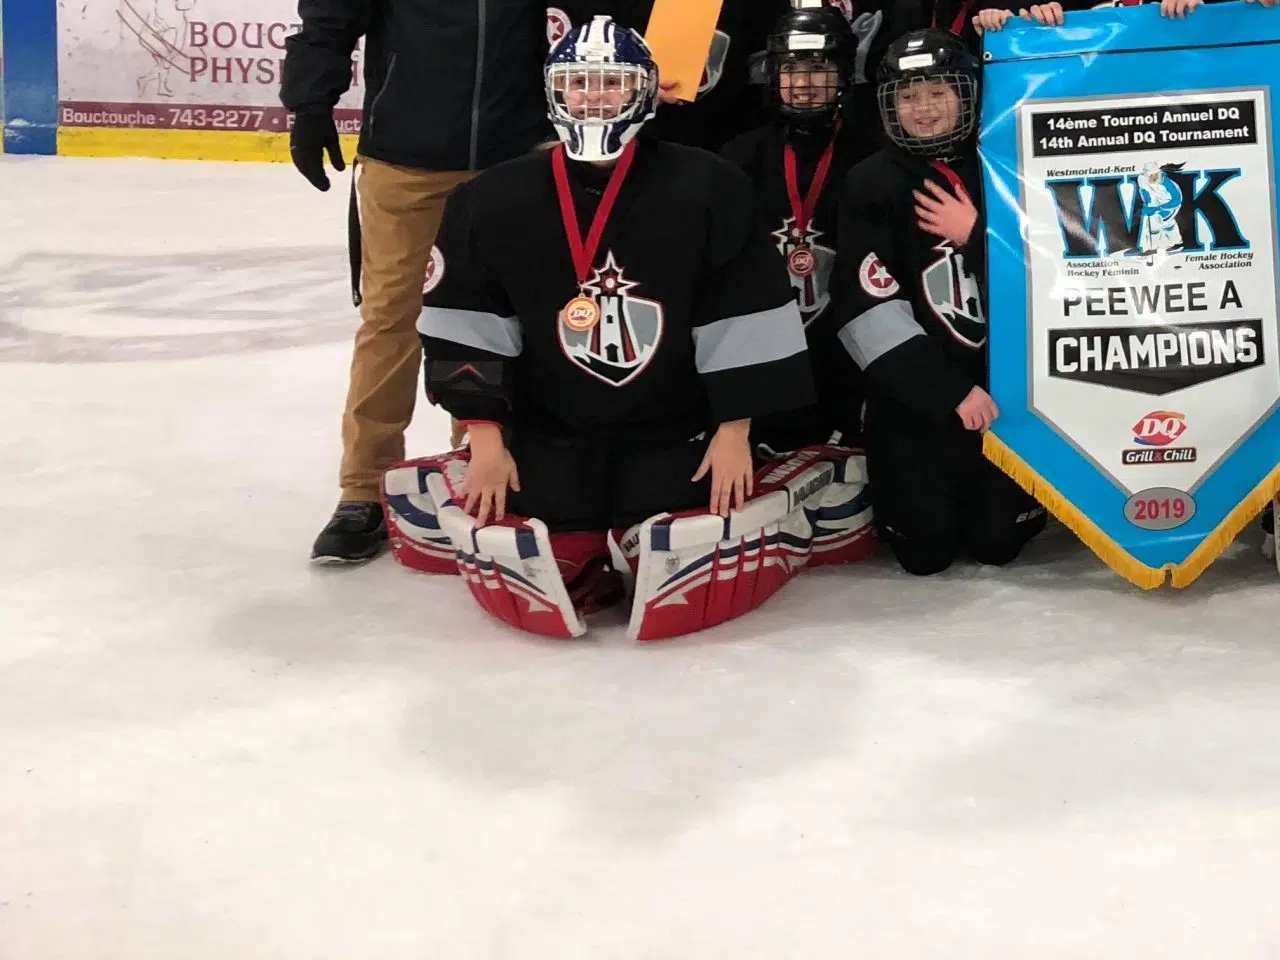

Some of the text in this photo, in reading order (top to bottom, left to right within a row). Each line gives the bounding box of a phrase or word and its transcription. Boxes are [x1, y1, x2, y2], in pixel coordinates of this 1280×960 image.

[62, 107, 156, 129] Bouctouche
[168, 107, 264, 128] 743-2277
[1046, 107, 1240, 131] 14ème Tournoi Annuel DQ
[1039, 125, 1249, 150] 14th Annual DQ Tournament
[1046, 165, 1136, 178] Westmorland-Kent
[1066, 259, 1120, 268] Association
[1184, 251, 1254, 263] Female Hockey
[1198, 260, 1252, 271] Association
[1067, 268, 1100, 279] Hockey
[1064, 279, 1243, 317] PEEWEE A
[1055, 327, 1258, 373] CHAMPIONS
[1139, 417, 1181, 439] DQ
[1125, 450, 1154, 463] Grill
[1163, 449, 1193, 461] Chill
[1133, 497, 1186, 521] 2019
